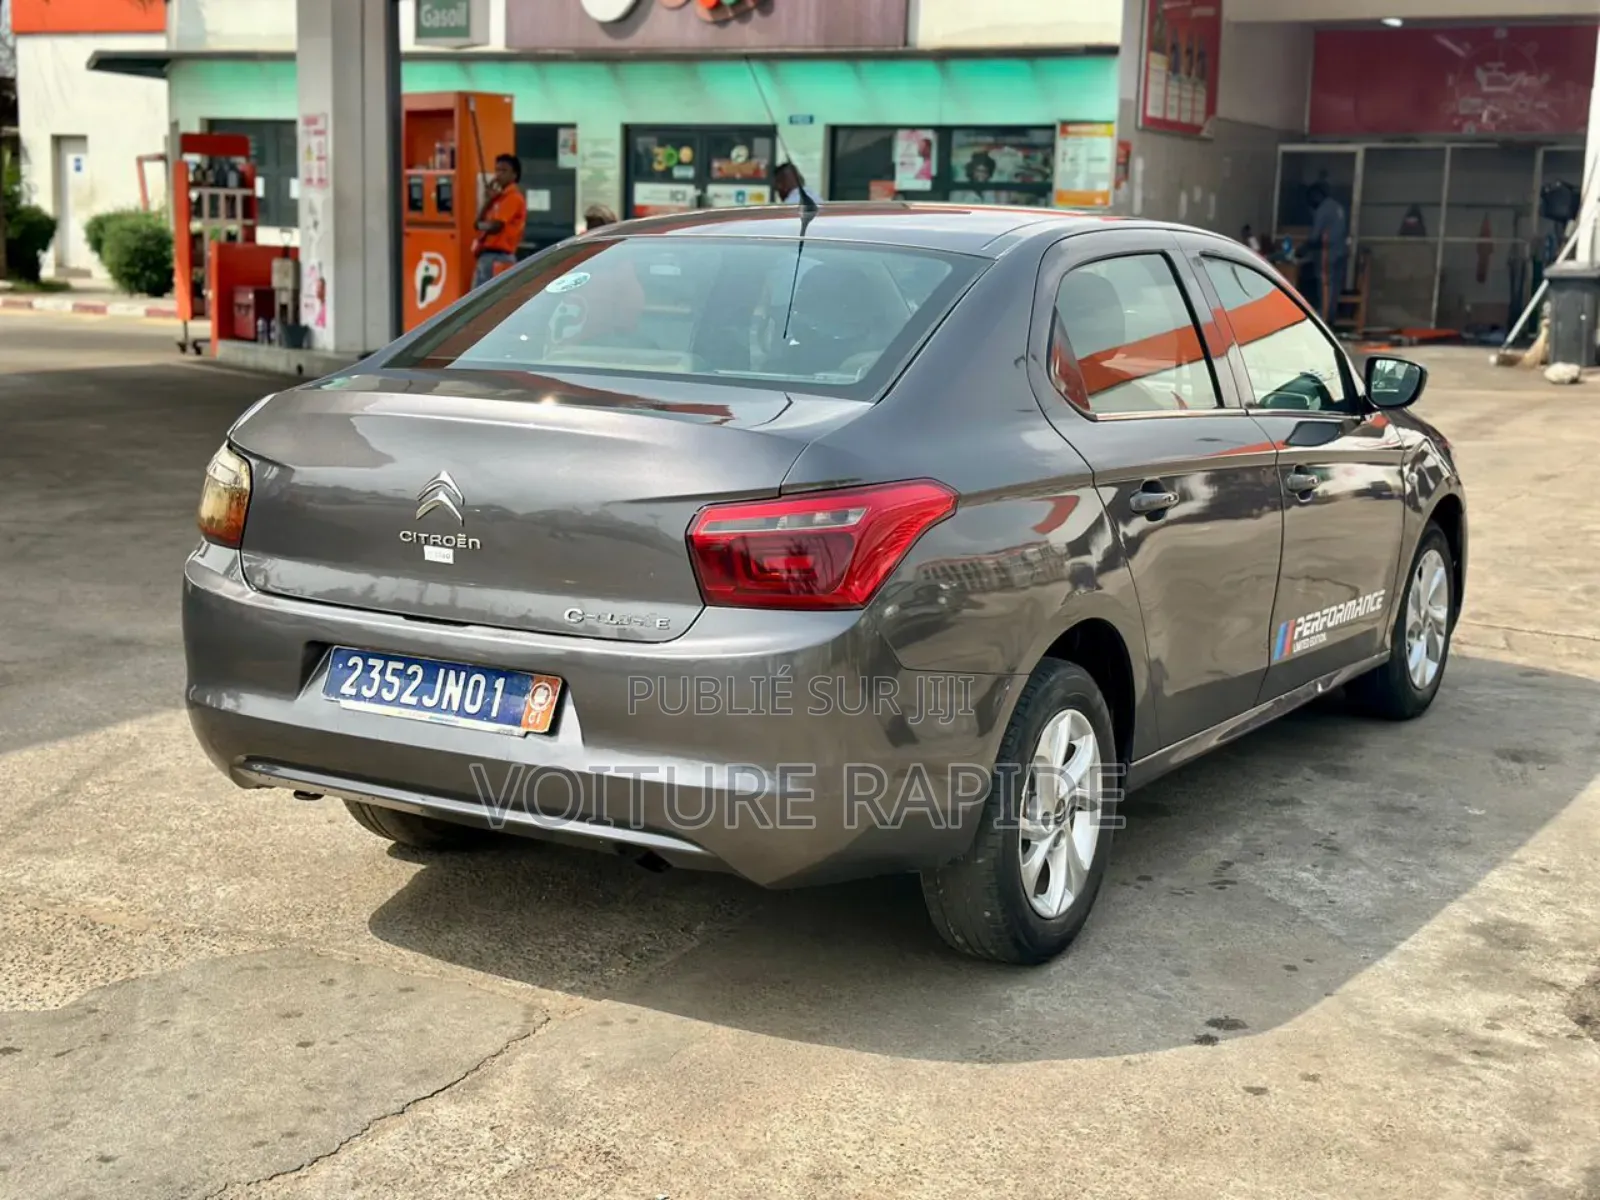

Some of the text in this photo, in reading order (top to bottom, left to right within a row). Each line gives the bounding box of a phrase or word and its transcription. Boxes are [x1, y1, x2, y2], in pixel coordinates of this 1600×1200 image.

[420, 2, 467, 28] Gasoil
[1294, 589, 1386, 640] PERFORMANCE
[339, 655, 506, 718] 2352JN01
